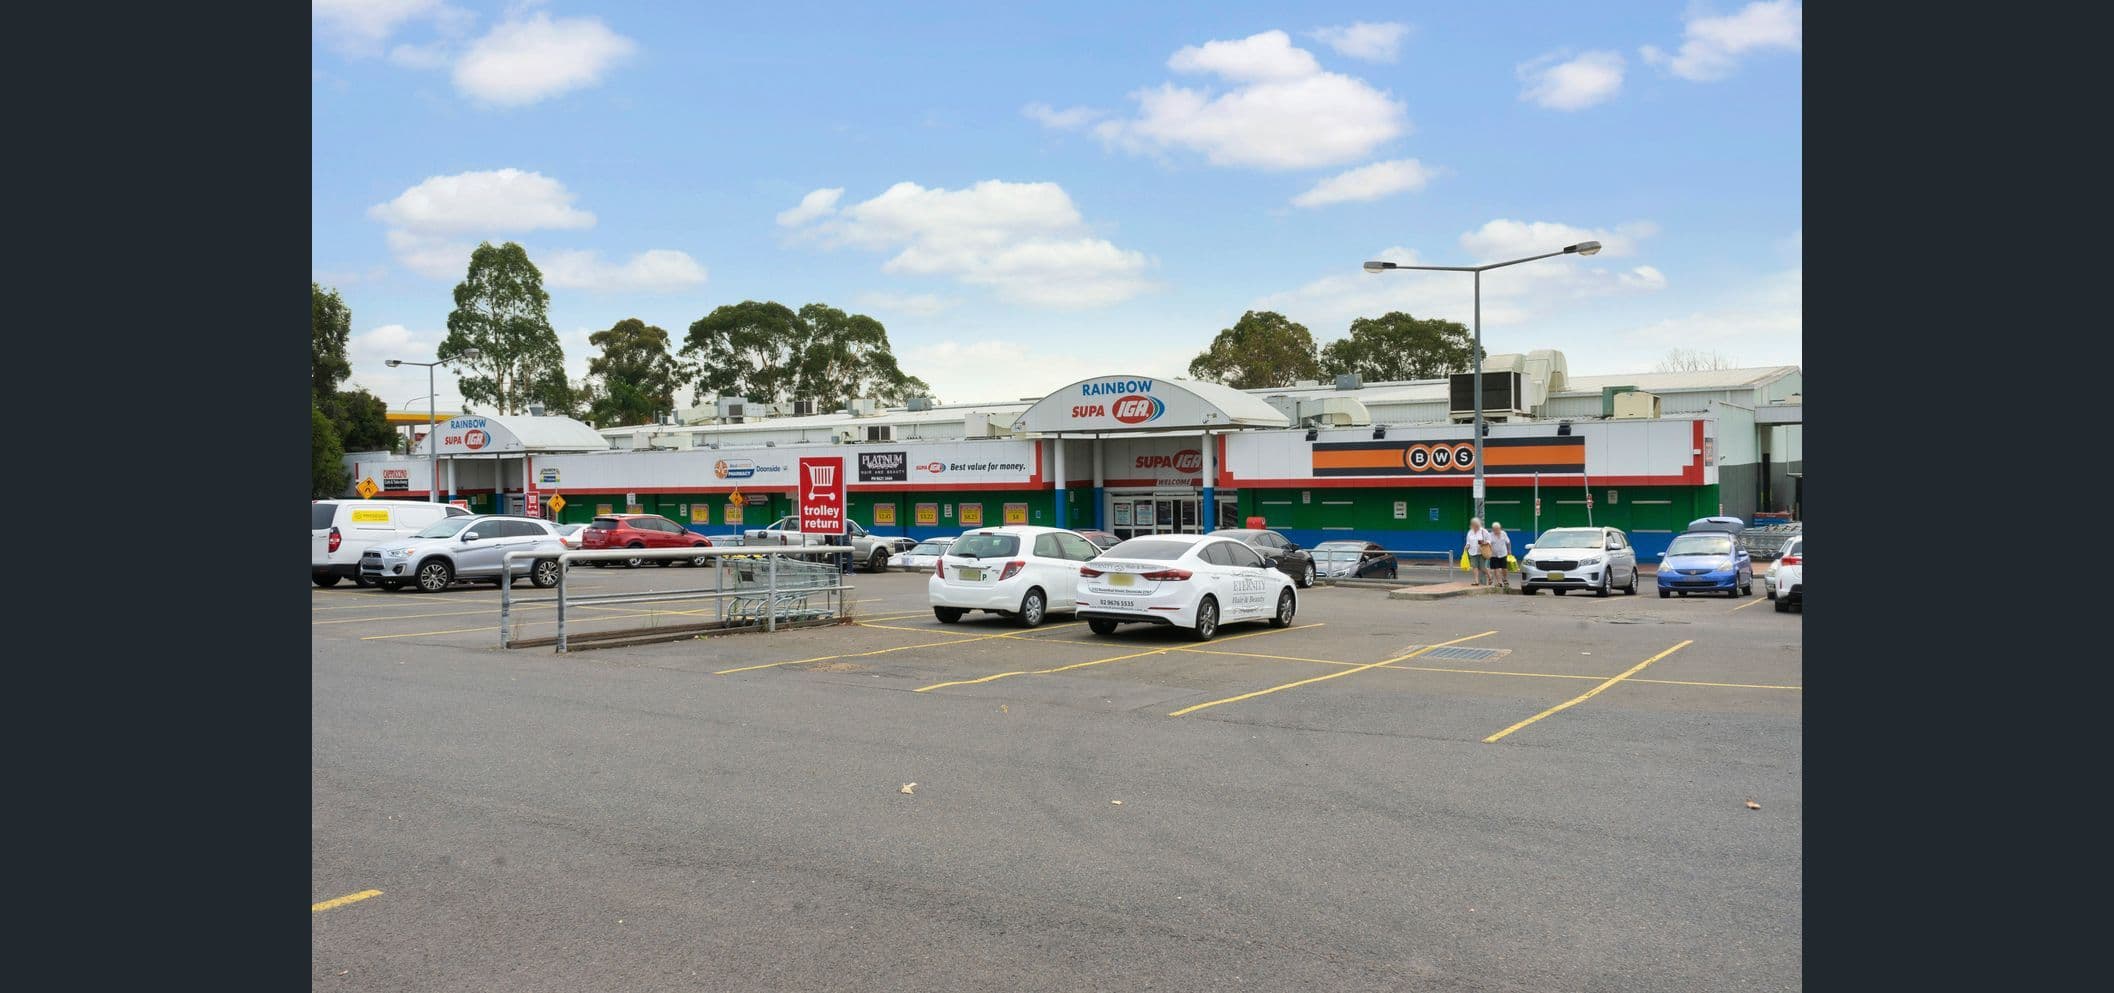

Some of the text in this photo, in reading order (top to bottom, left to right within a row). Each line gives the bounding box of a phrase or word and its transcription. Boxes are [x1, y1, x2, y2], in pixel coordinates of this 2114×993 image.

[1082, 380, 1153, 396] RAINBOW
[1072, 400, 1150, 418] SUPA IGA
[450, 419, 487, 429] RAINBOW
[444, 432, 484, 445] SUPA IGA
[862, 454, 903, 465] PLATINUM
[1135, 454, 1201, 468] SUPA IGA
[756, 464, 780, 472] Doonside
[950, 462, 1026, 472] Best value for money.
[803, 505, 840, 518] trolley
[804, 518, 839, 528] return
[1233, 579, 1265, 591] ETERNITY
